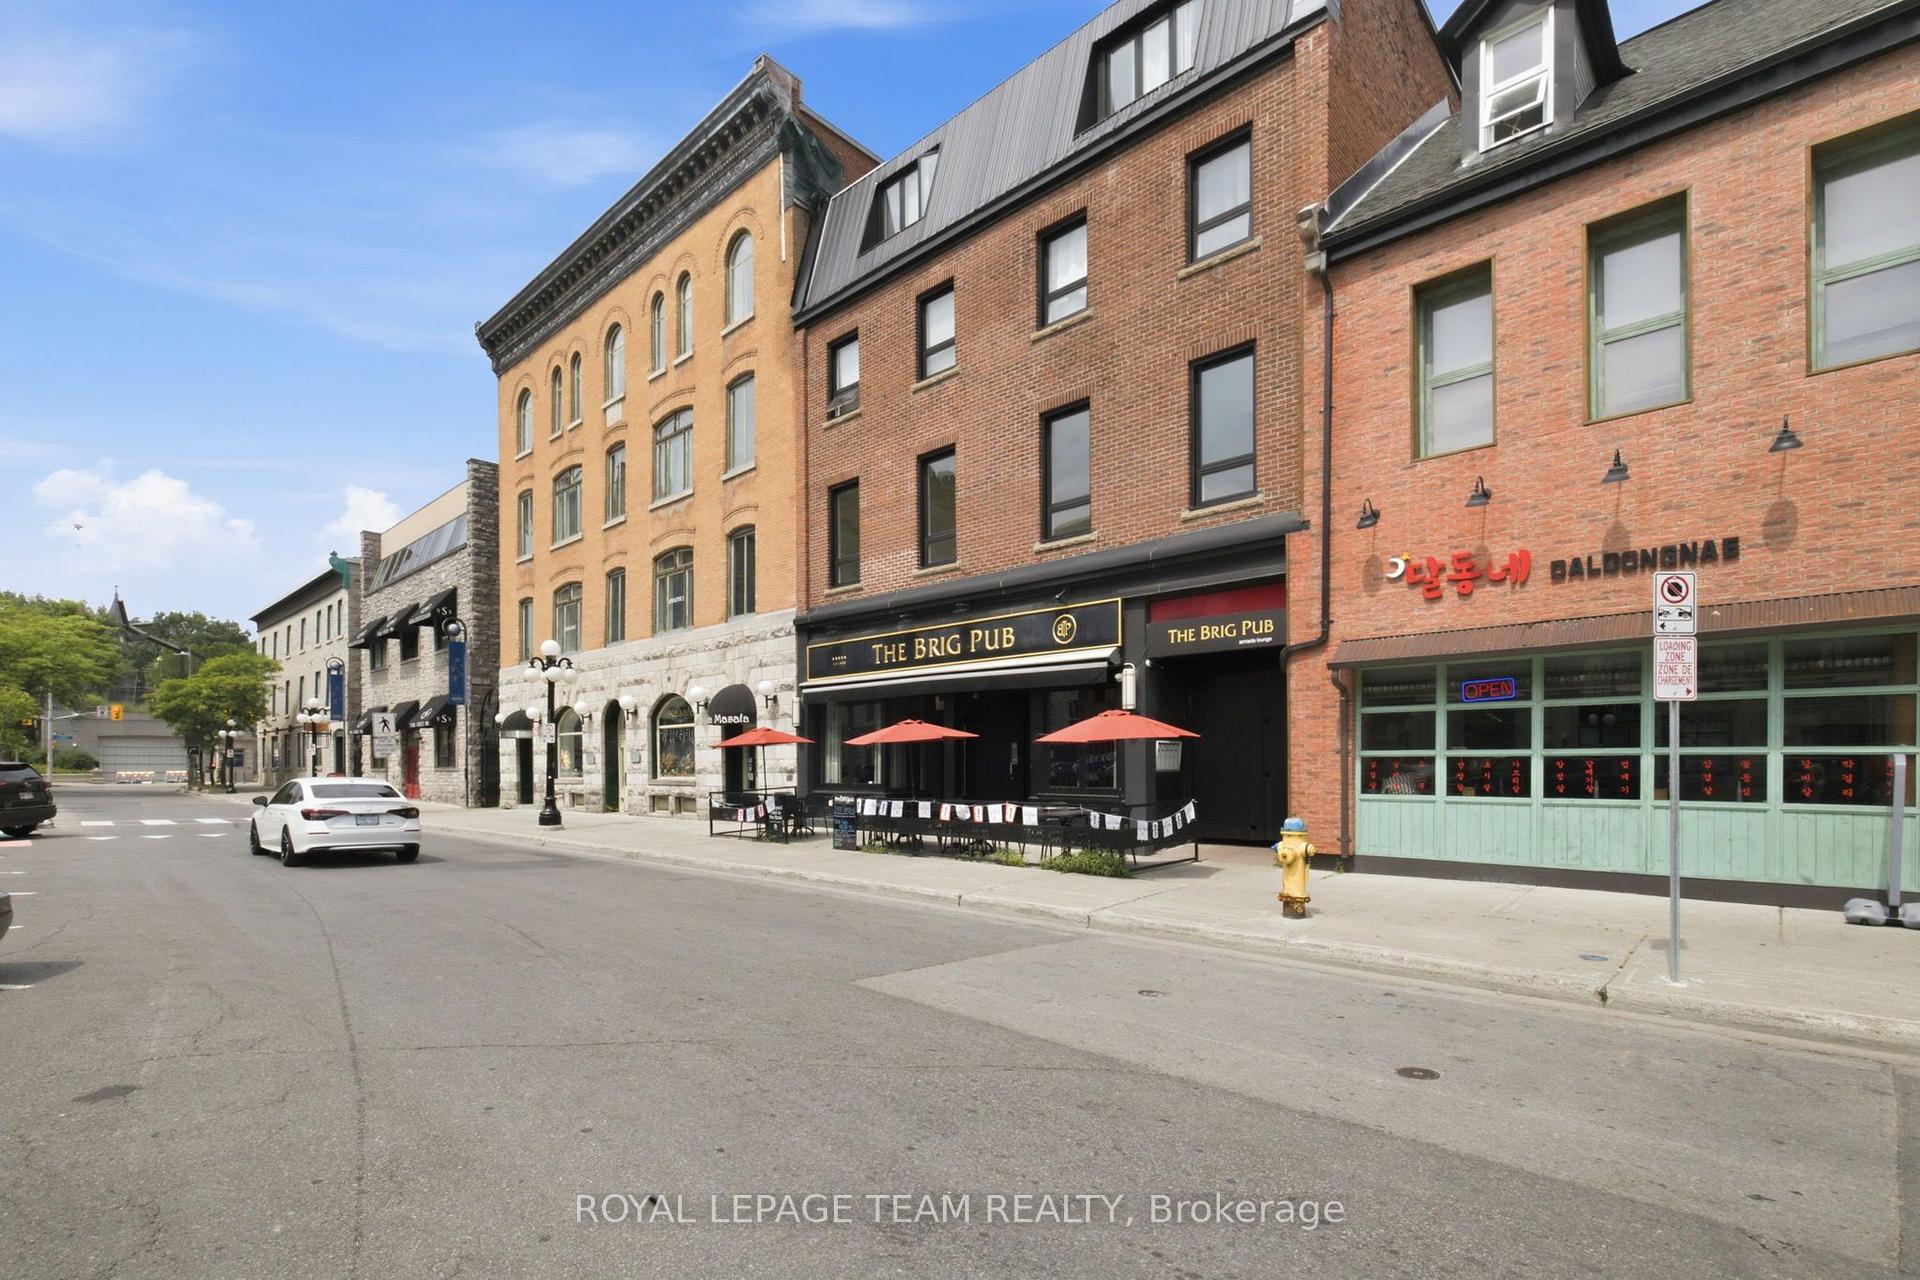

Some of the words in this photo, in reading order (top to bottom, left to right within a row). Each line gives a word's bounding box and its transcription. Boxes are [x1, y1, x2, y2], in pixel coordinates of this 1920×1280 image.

[1550, 536, 1740, 581] DALDONGNAE
[1405, 549, 1532, 599] 달동네
[1167, 628, 1196, 643] THE
[1200, 624, 1237, 640] BRIG
[1242, 619, 1275, 635] PUB
[872, 643, 907, 664] THE
[914, 634, 961, 660] BRIG
[970, 627, 1015, 653] PUB
[1659, 640, 1692, 651] LOADING
[1665, 652, 1685, 661] ZONE
[1658, 665, 1678, 675] ZONE
[1682, 665, 1692, 675] DE
[1658, 676, 1692, 685] CHARGEMENT
[1465, 682, 1512, 698] OPEN
